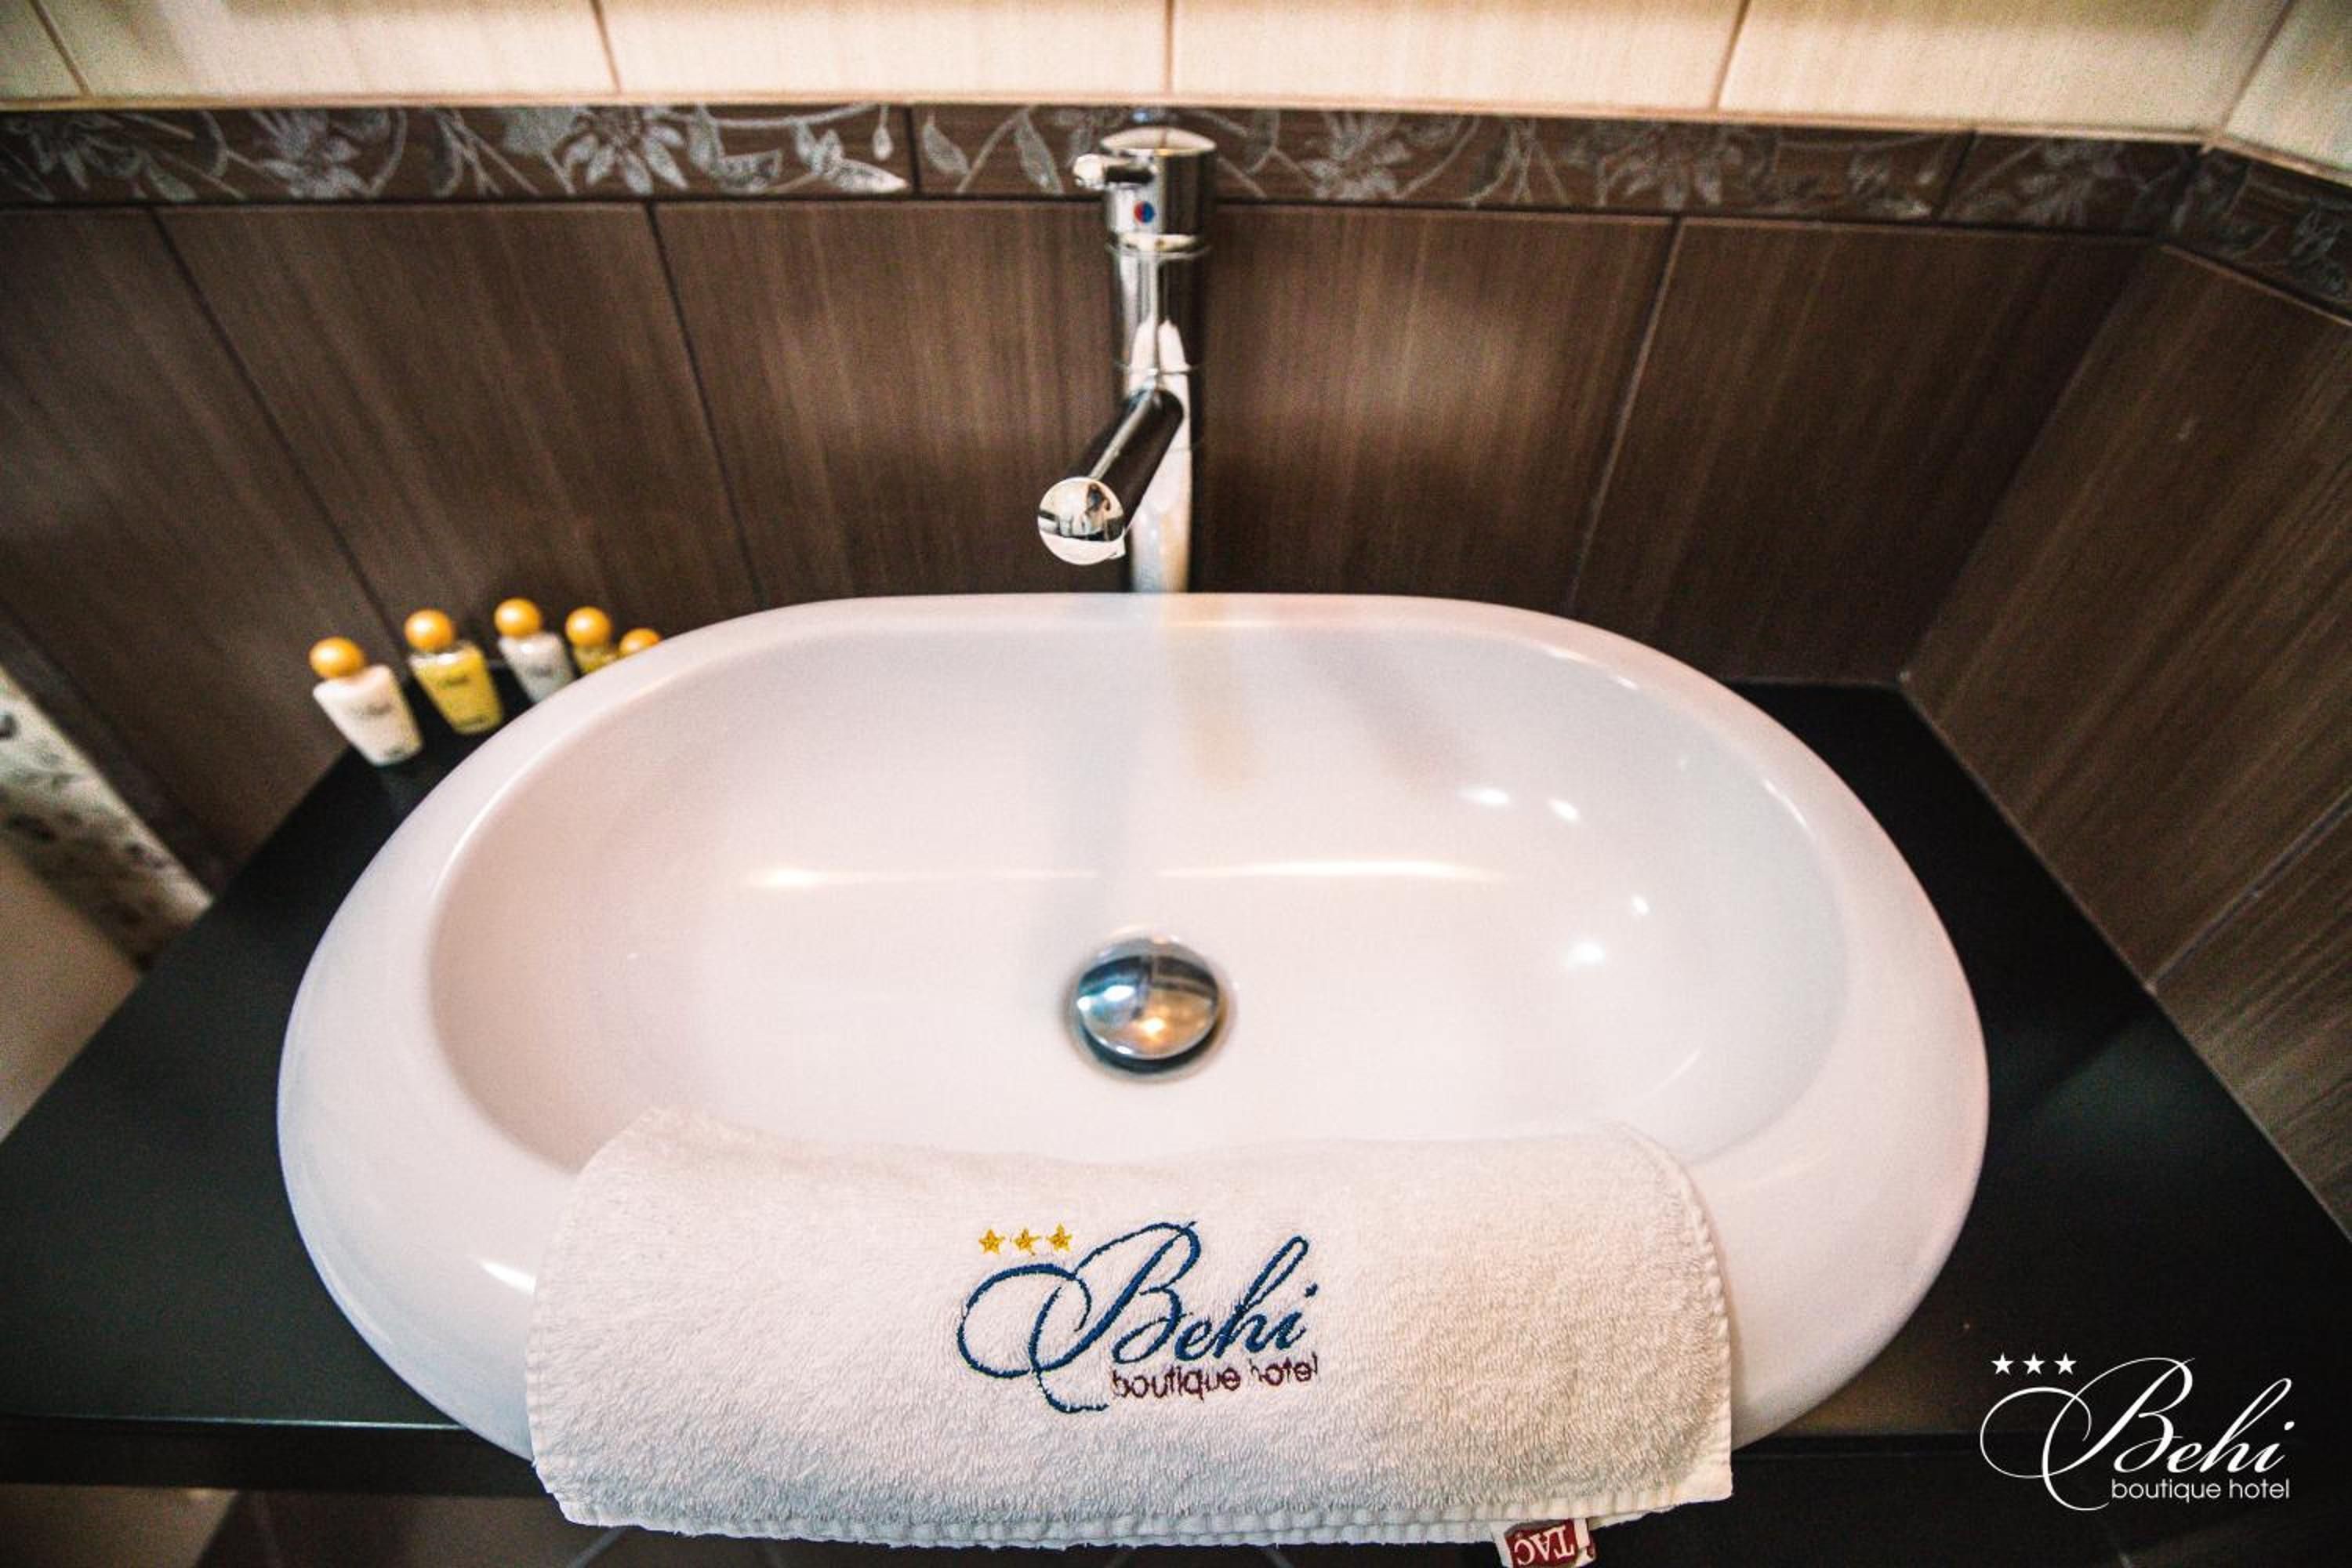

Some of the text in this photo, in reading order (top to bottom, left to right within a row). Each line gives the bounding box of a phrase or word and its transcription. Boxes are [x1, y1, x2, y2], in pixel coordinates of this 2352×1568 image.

[956, 1221, 1319, 1414] Behi
[1111, 1350, 1319, 1401] boutique hotel
